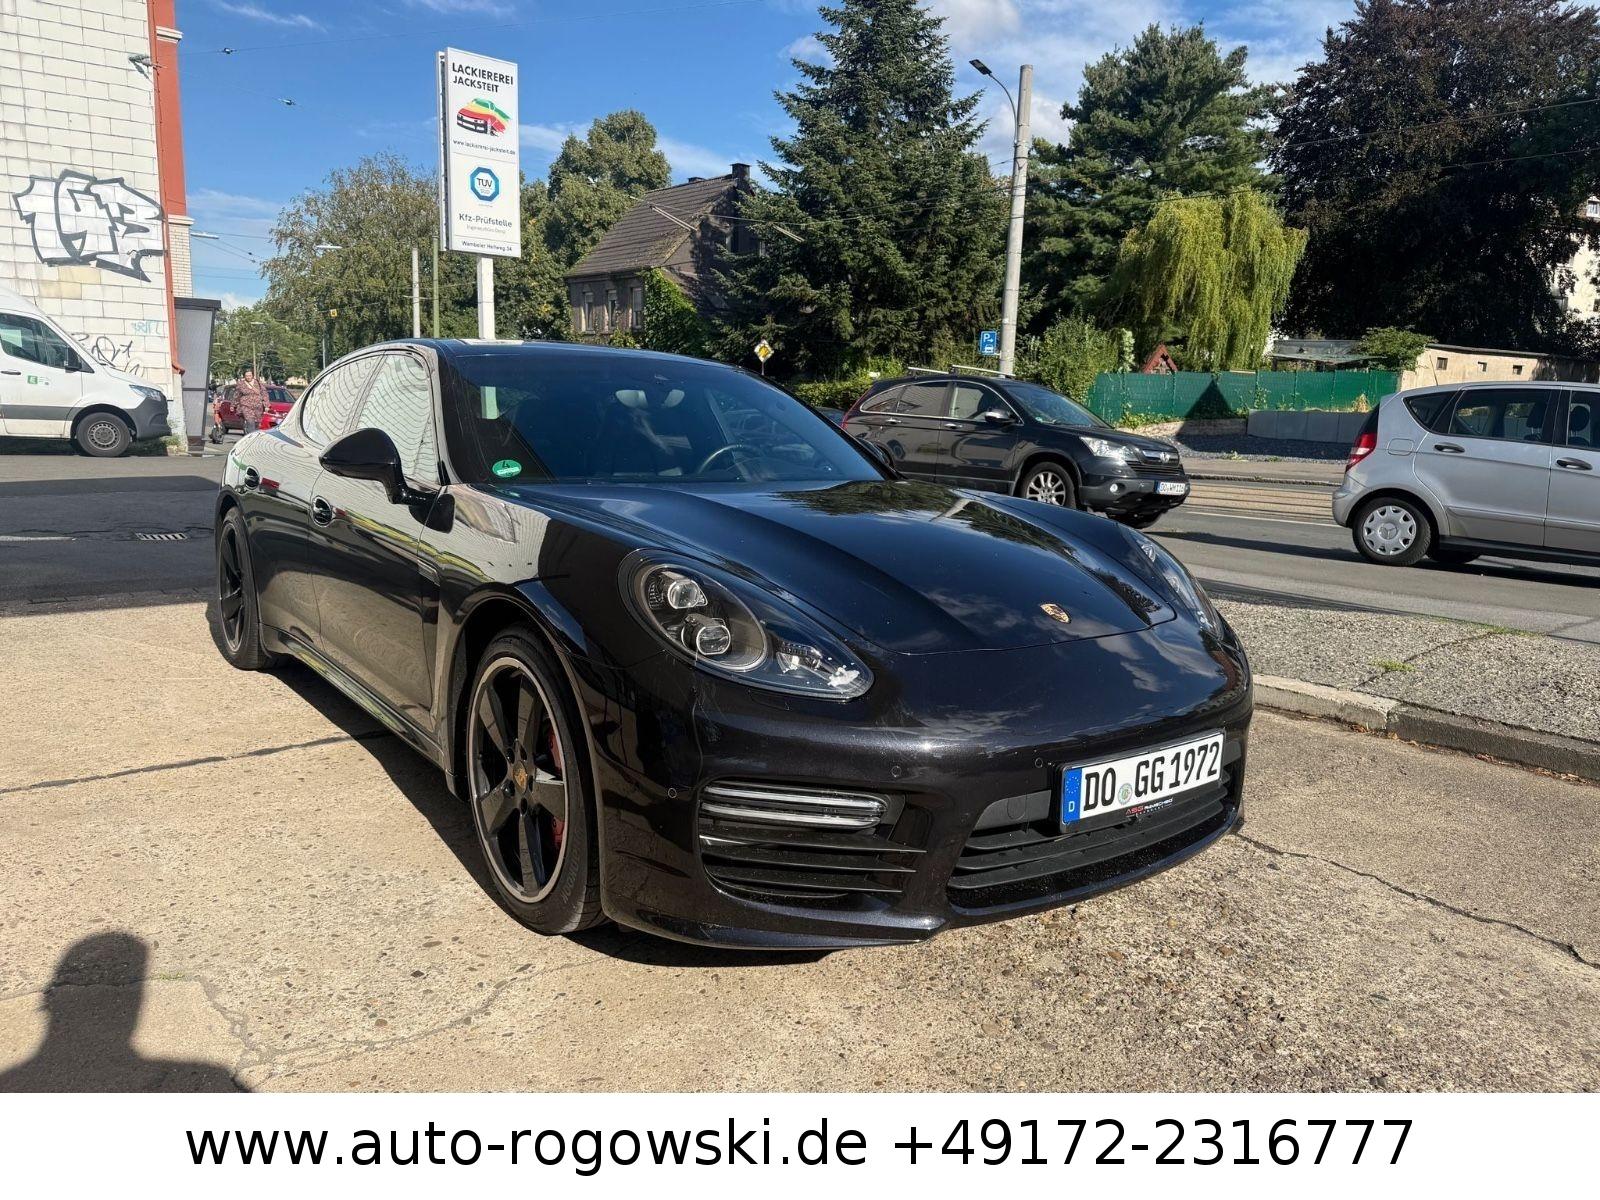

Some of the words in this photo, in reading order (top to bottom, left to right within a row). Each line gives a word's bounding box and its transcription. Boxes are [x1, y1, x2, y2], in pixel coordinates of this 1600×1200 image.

[452, 62, 514, 85] LACKIEREREI
[453, 76, 499, 93] JACKSTEIT
[459, 212, 513, 228] Kfz-Prüfstelle
[983, 333, 991, 343] P
[1068, 801, 1075, 813] D
[1083, 767, 1117, 812] DO
[1134, 755, 1165, 798] GG
[1168, 741, 1221, 789] 1972
